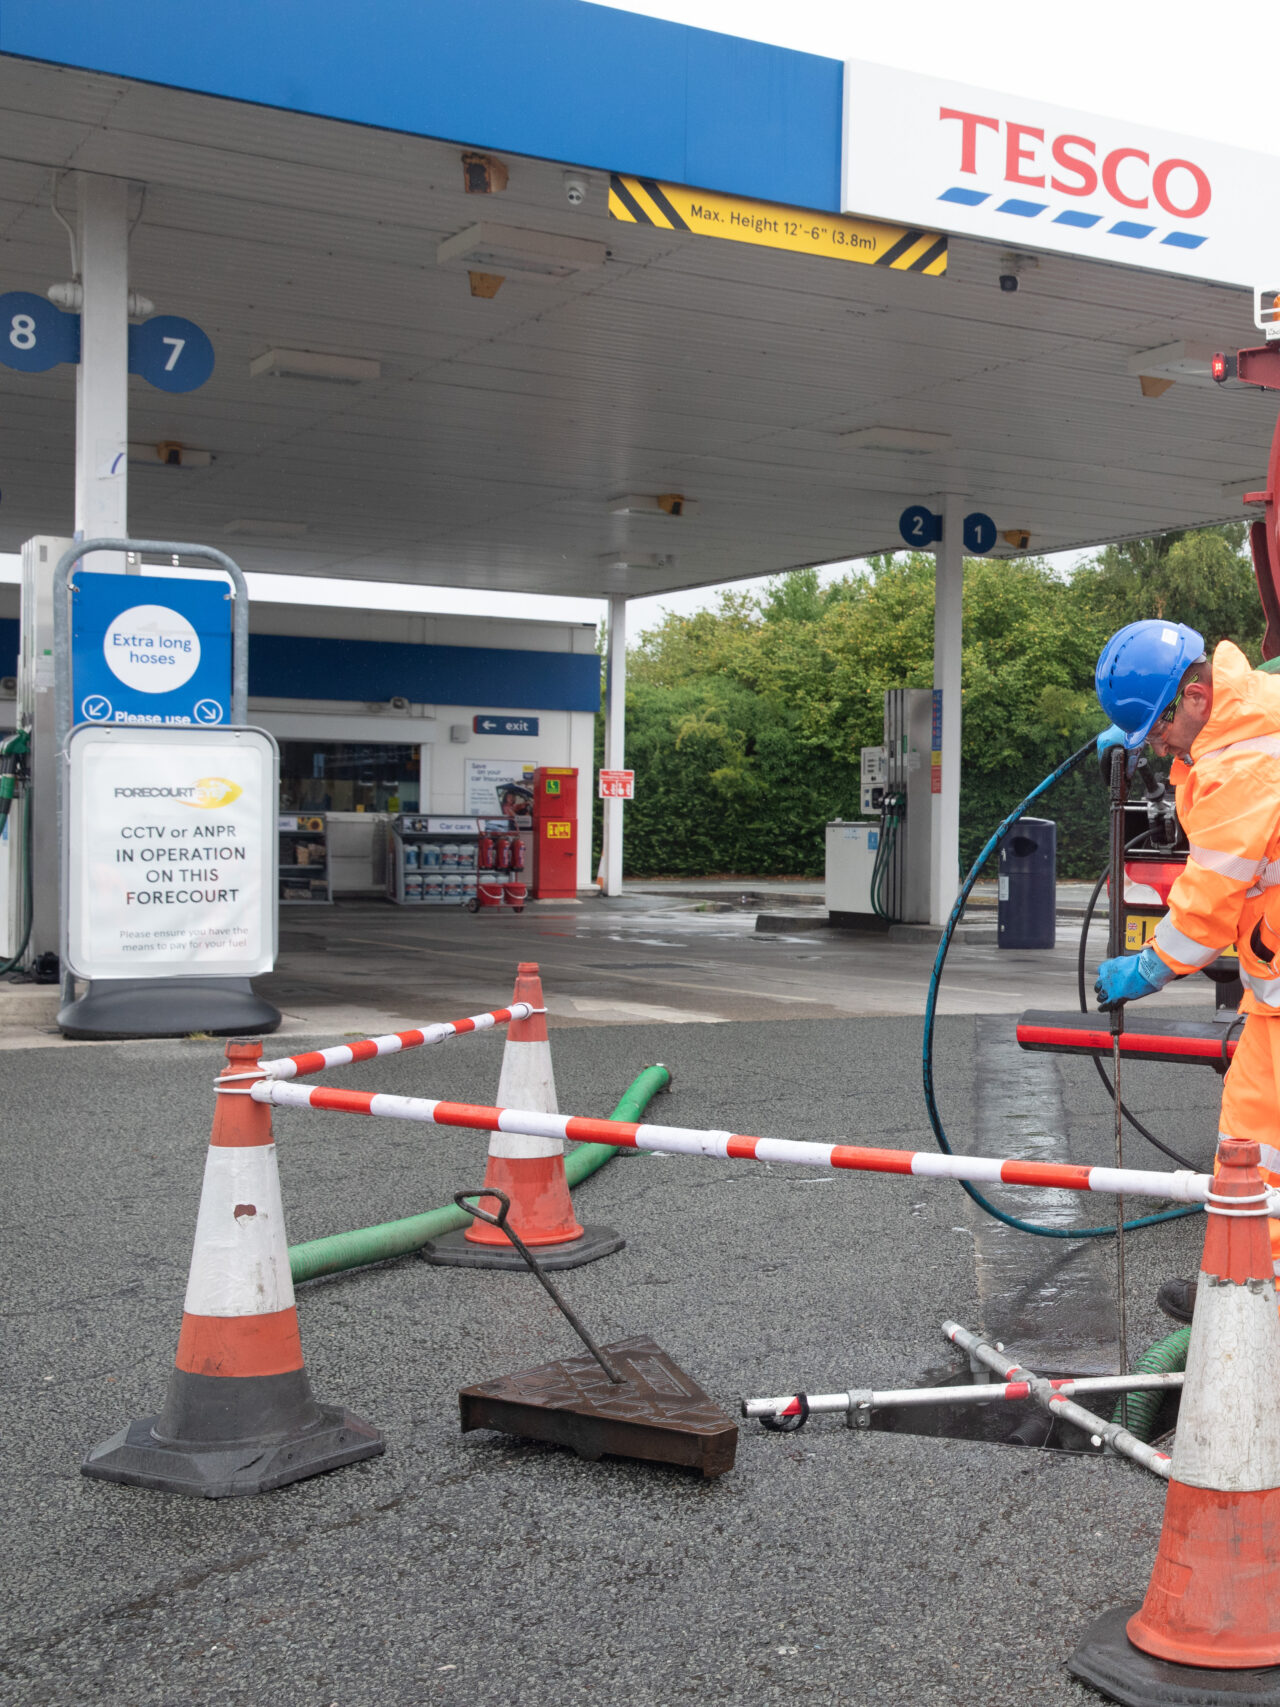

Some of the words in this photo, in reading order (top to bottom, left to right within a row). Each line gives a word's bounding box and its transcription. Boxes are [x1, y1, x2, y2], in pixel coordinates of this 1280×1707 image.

[939, 106, 1212, 219] TESCO
[690, 204, 725, 223] Max.
[730, 211, 779, 233] Height
[832, 230, 877, 251] (3.8m)
[9, 314, 37, 350] 8
[162, 336, 186, 371] 7
[912, 516, 924, 535] 2
[974, 525, 982, 544] 1
[112, 633, 154, 648] Extra
[159, 635, 192, 652] long
[129, 651, 176, 665] hoses
[115, 711, 162, 724] Please
[165, 715, 191, 725] use
[505, 718, 529, 732] exit
[114, 788, 195, 798] FORECOURT
[121, 826, 165, 839] CCTV
[170, 827, 188, 838] or
[193, 825, 236, 837] ANPR
[116, 849, 134, 862] IN
[140, 847, 246, 862] OPERATION
[146, 870, 173, 883] ON
[179, 869, 219, 882] THIS
[126, 889, 239, 905] FORECOURT
[120, 930, 151, 938] Please
[153, 929, 186, 938] ensure
[188, 929, 206, 938] you
[208, 928, 231, 936] have
[232, 926, 248, 935] the
[122, 943, 155, 951] means
[170, 941, 186, 951] pay
[189, 940, 205, 949] for
[205, 940, 226, 949] your
[229, 938, 247, 947] fuel
